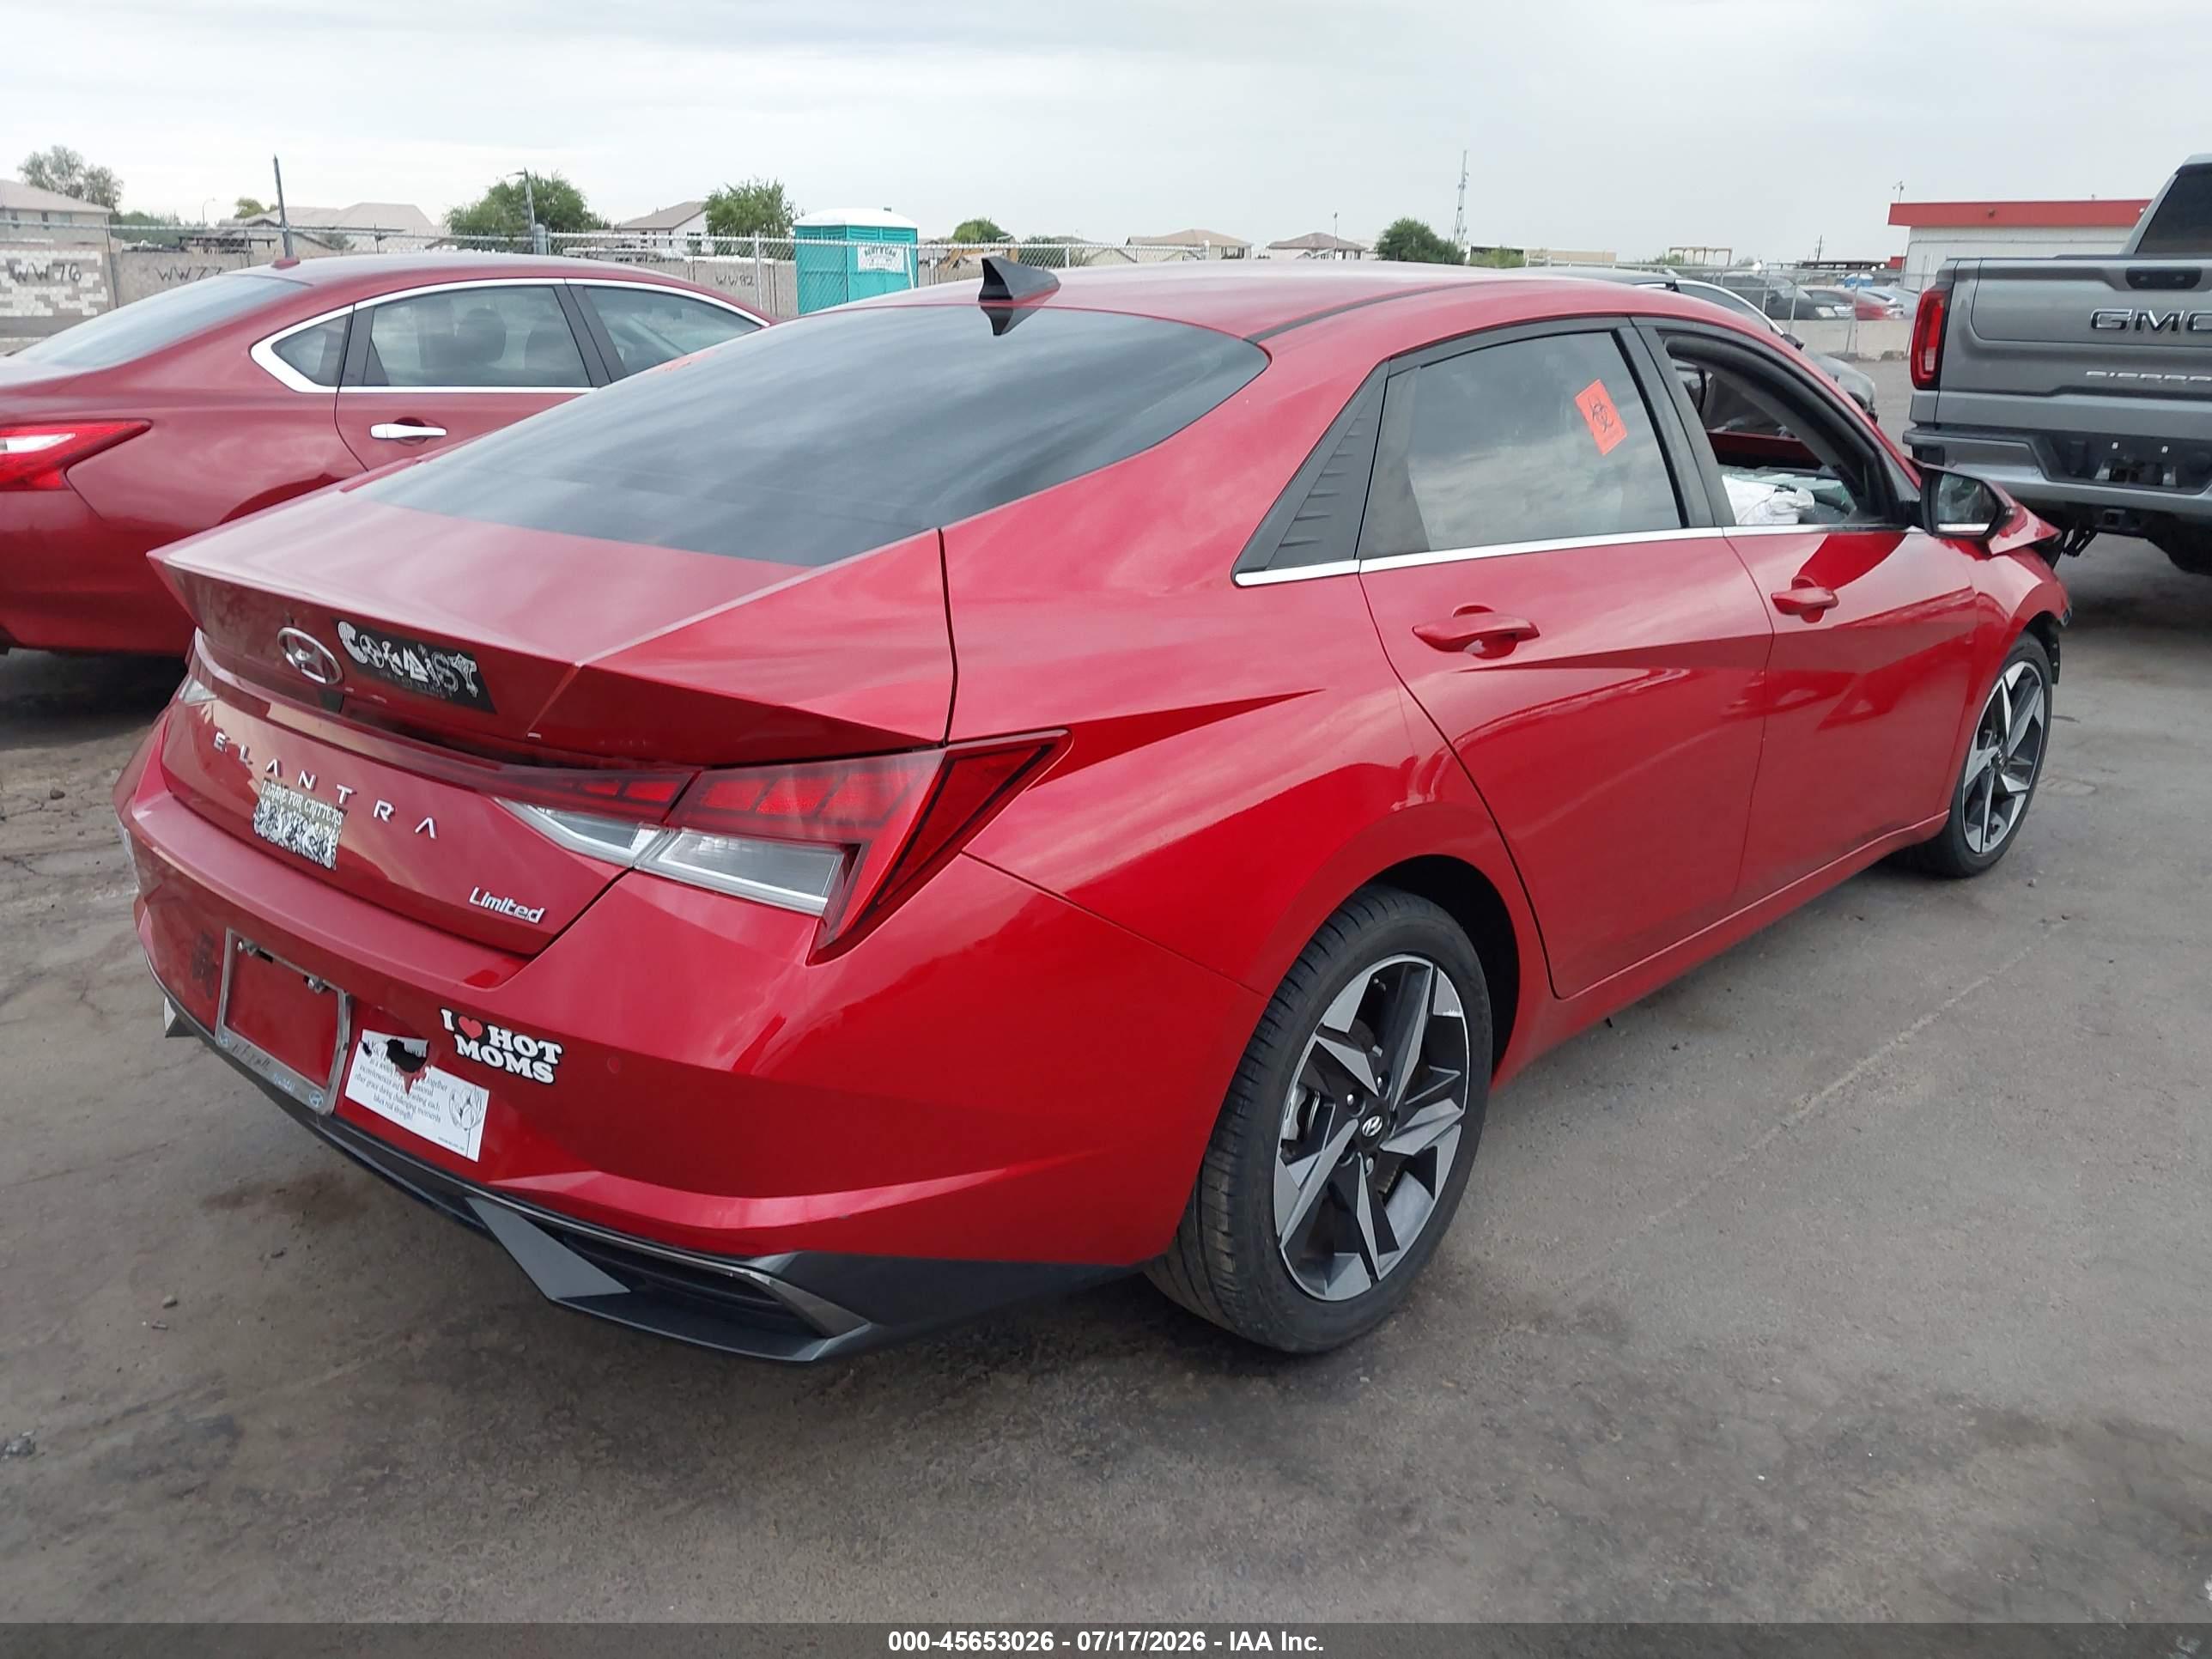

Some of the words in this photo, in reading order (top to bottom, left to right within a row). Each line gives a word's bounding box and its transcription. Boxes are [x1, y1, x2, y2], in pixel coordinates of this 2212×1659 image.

[6, 260, 82, 283] WW76
[2090, 308, 2212, 331] GMC
[213, 732, 438, 838] ELANTRA
[469, 886, 545, 924] Limited
[441, 1008, 454, 1031] I
[487, 1024, 563, 1065] HOT
[454, 1034, 554, 1084] MOMS
